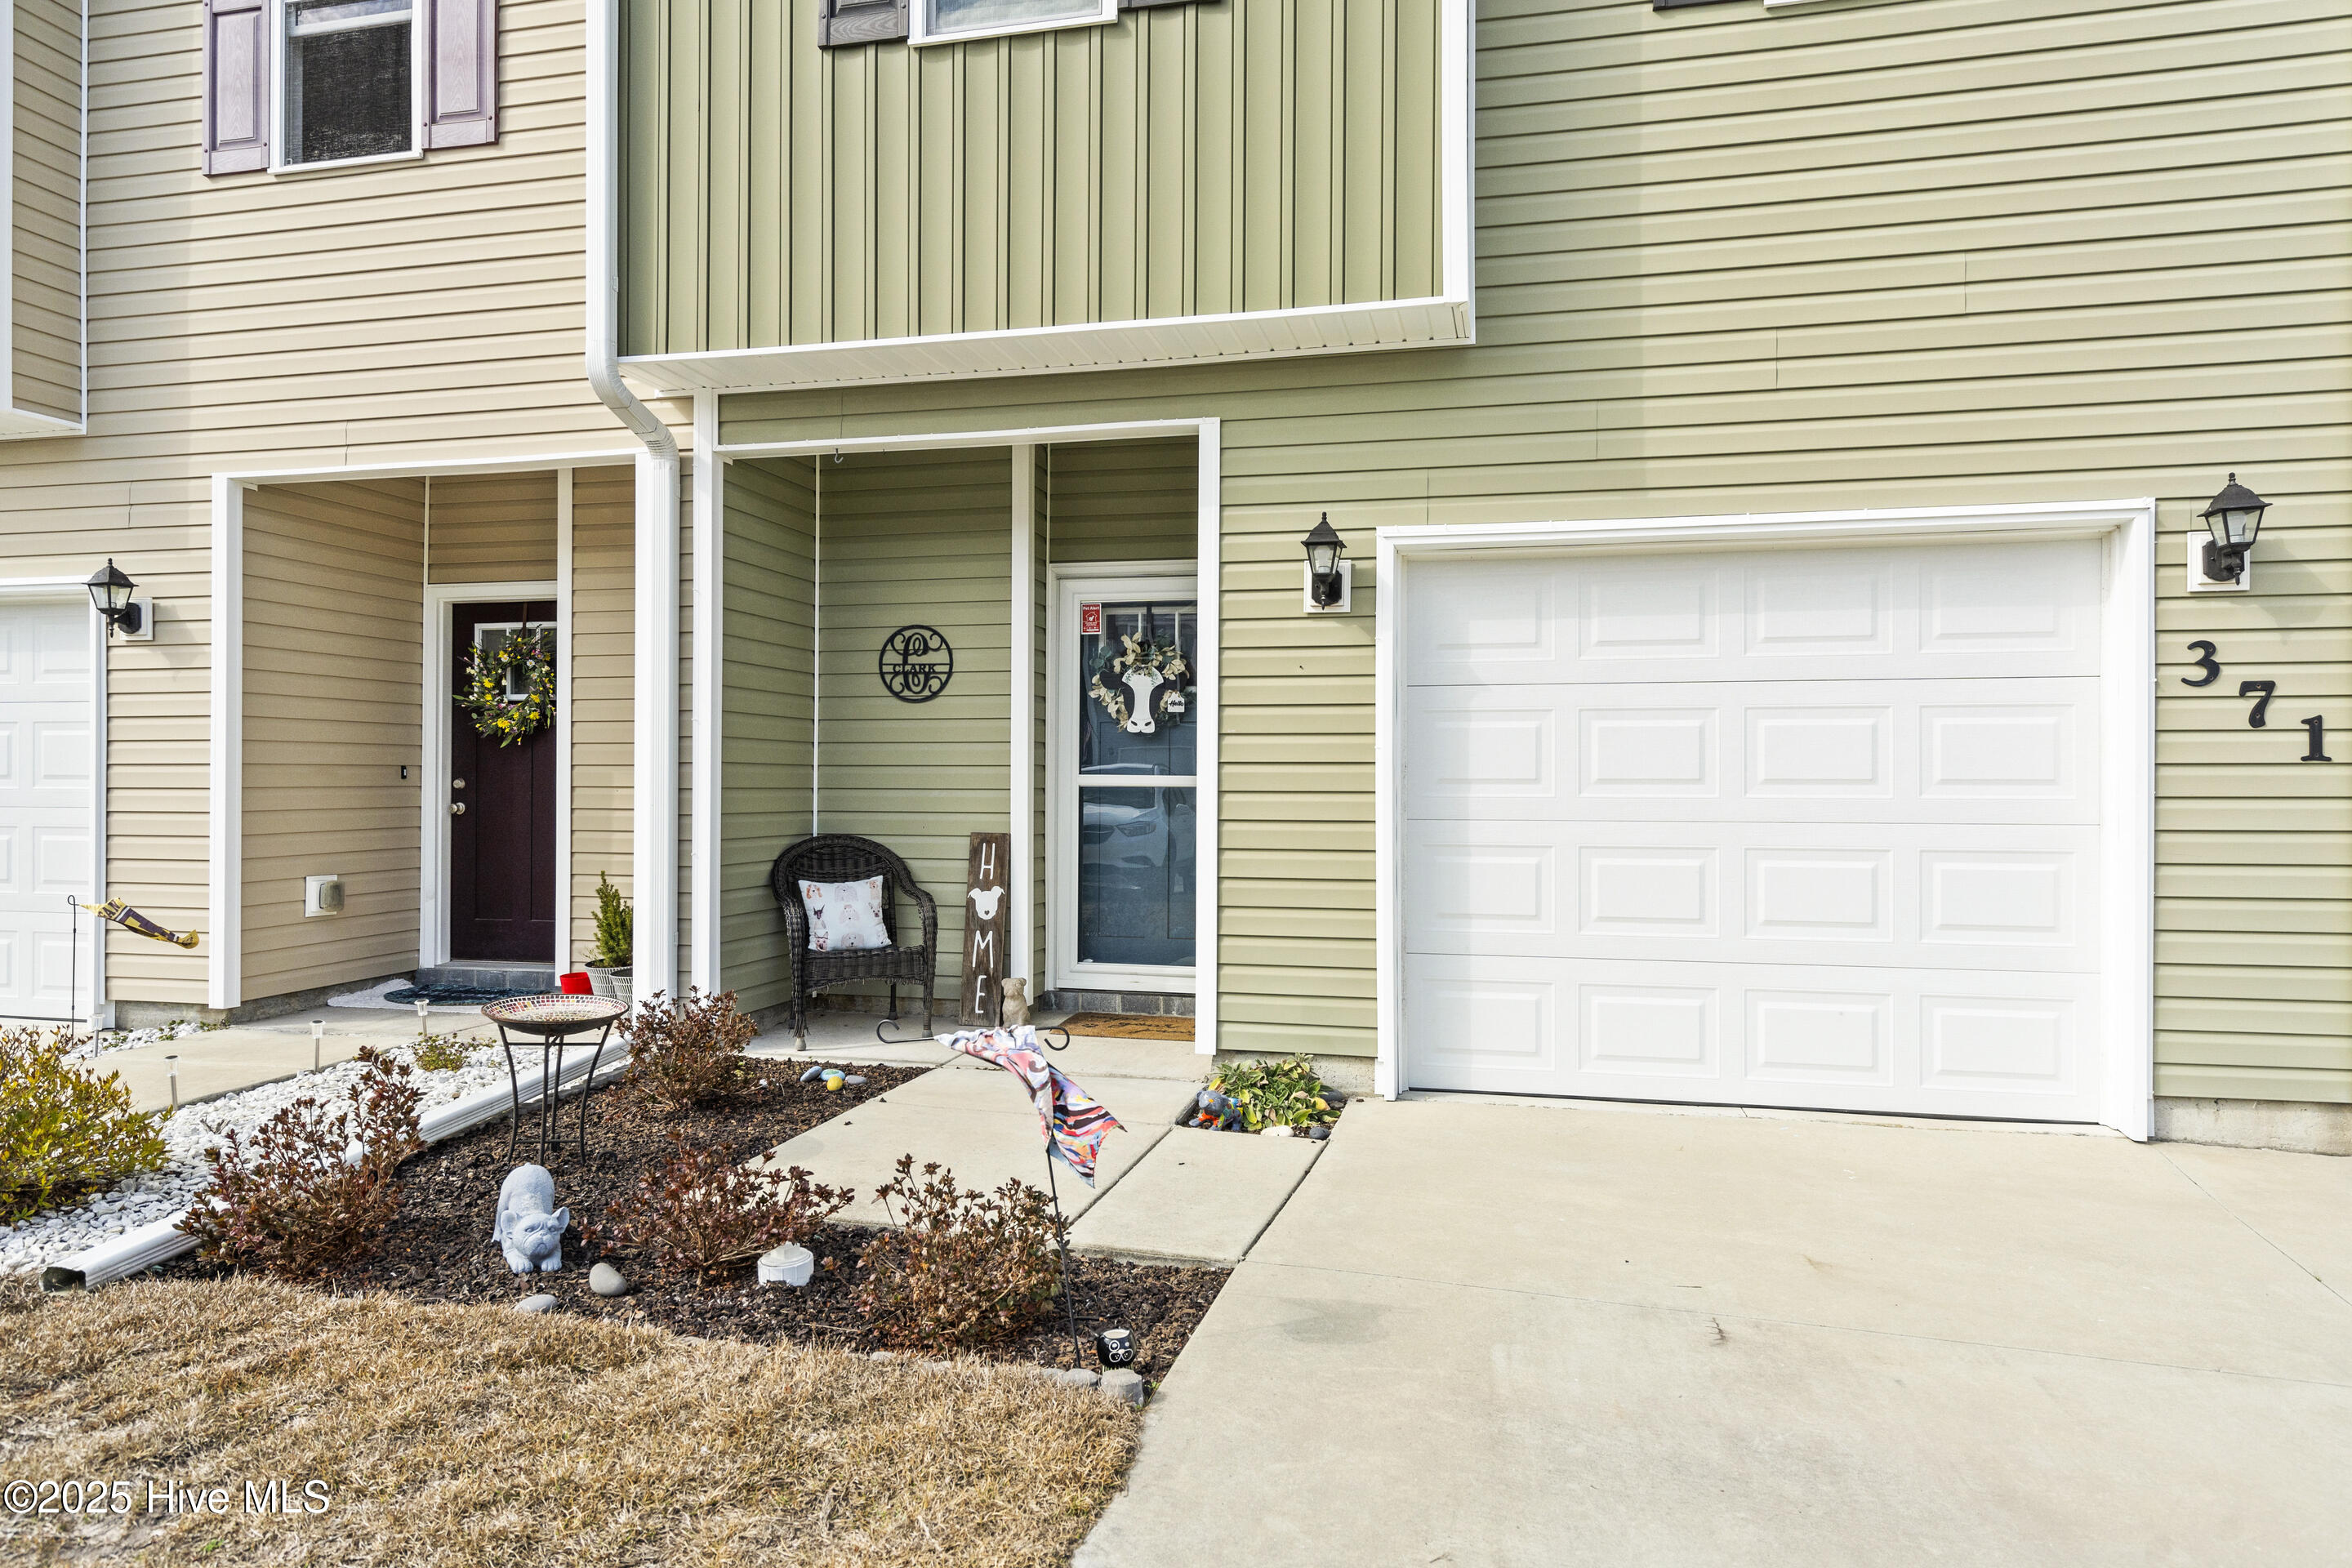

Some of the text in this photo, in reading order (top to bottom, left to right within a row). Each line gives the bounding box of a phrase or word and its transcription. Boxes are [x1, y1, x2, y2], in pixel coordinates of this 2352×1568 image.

[893, 663, 937, 675] CLARK
[1169, 699, 1184, 707] Hello
[2180, 640, 2332, 761] 371
